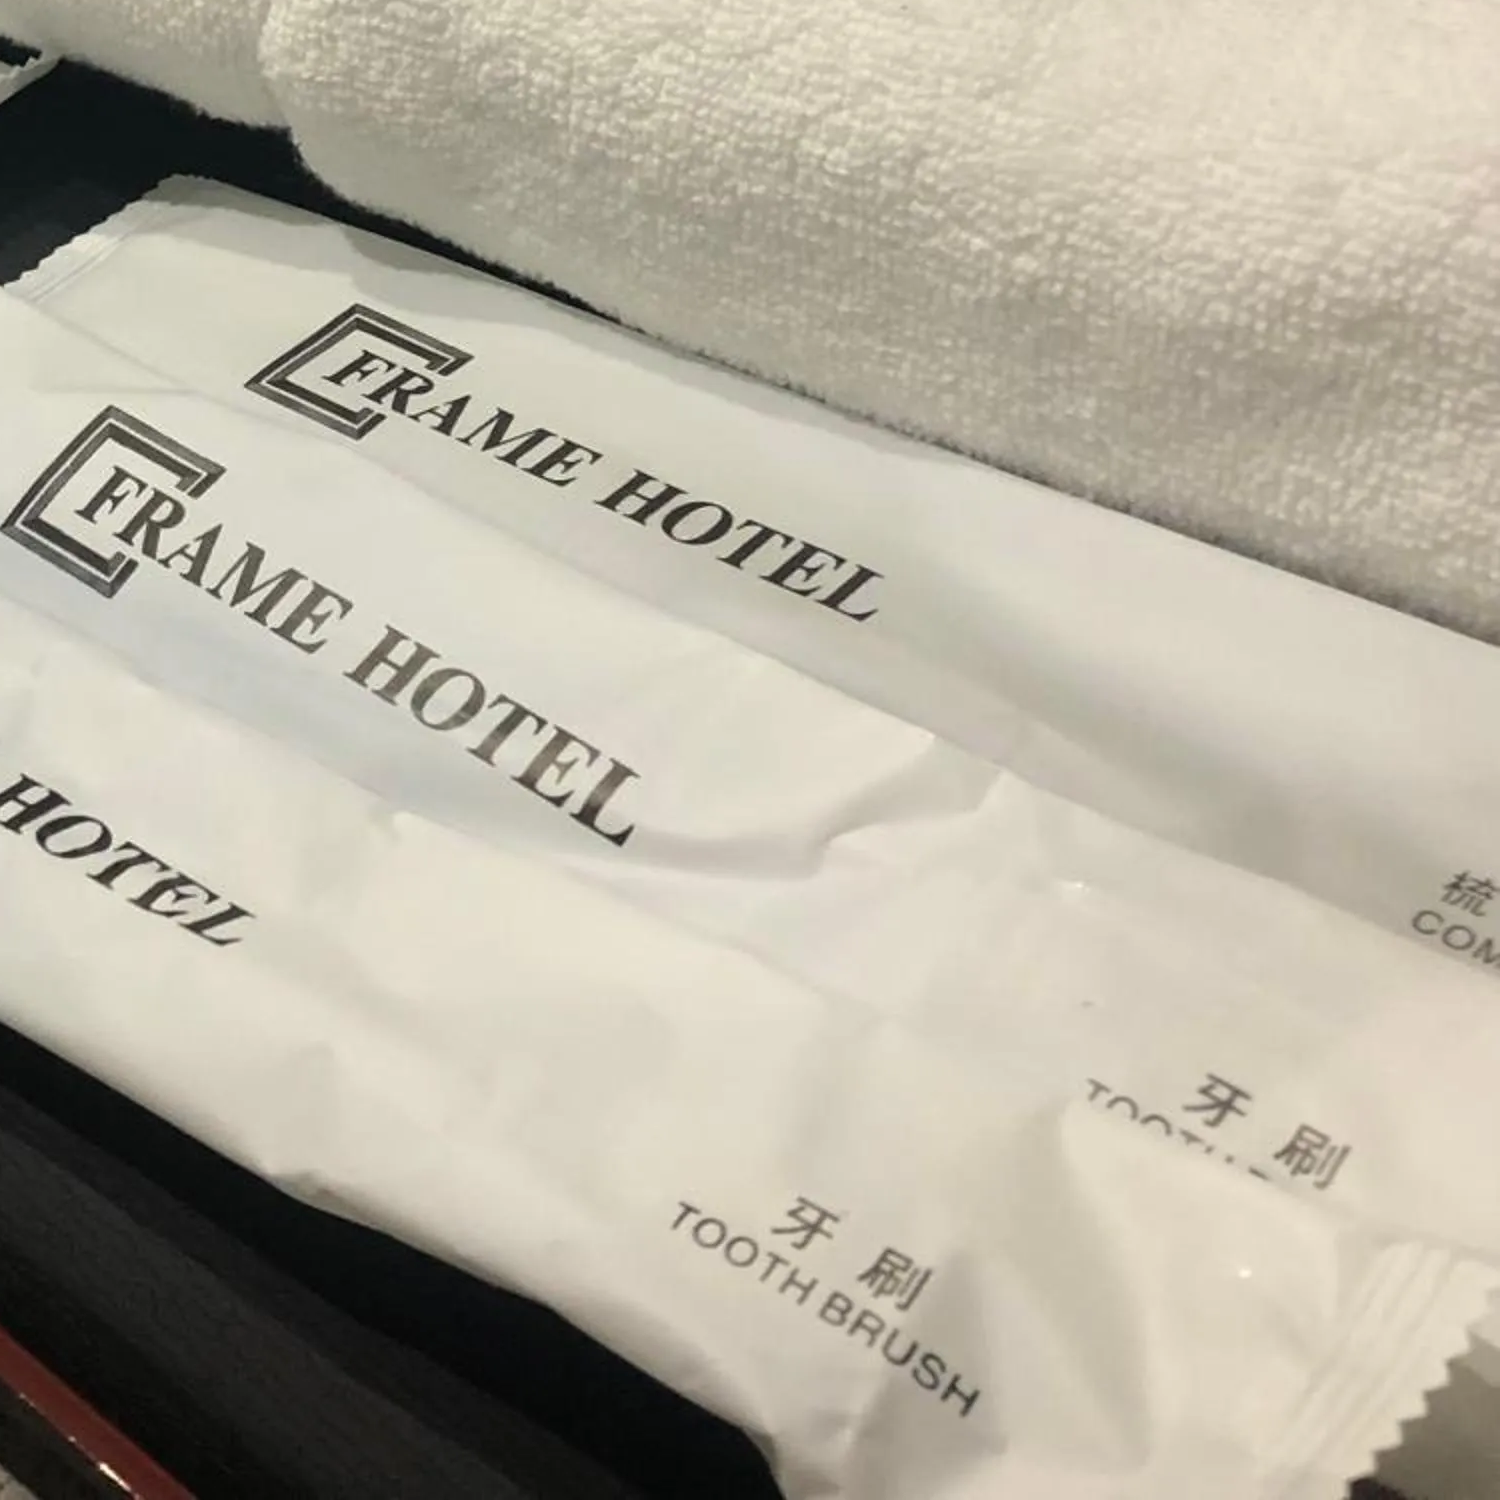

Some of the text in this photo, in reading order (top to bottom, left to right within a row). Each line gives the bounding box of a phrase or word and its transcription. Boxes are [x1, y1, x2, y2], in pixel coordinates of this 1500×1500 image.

[322, 349, 885, 622] FRAME HOTEL
[74, 465, 641, 847] FRAME HOTEL
[671, 1201, 980, 1417] TOOTH BRUSH
